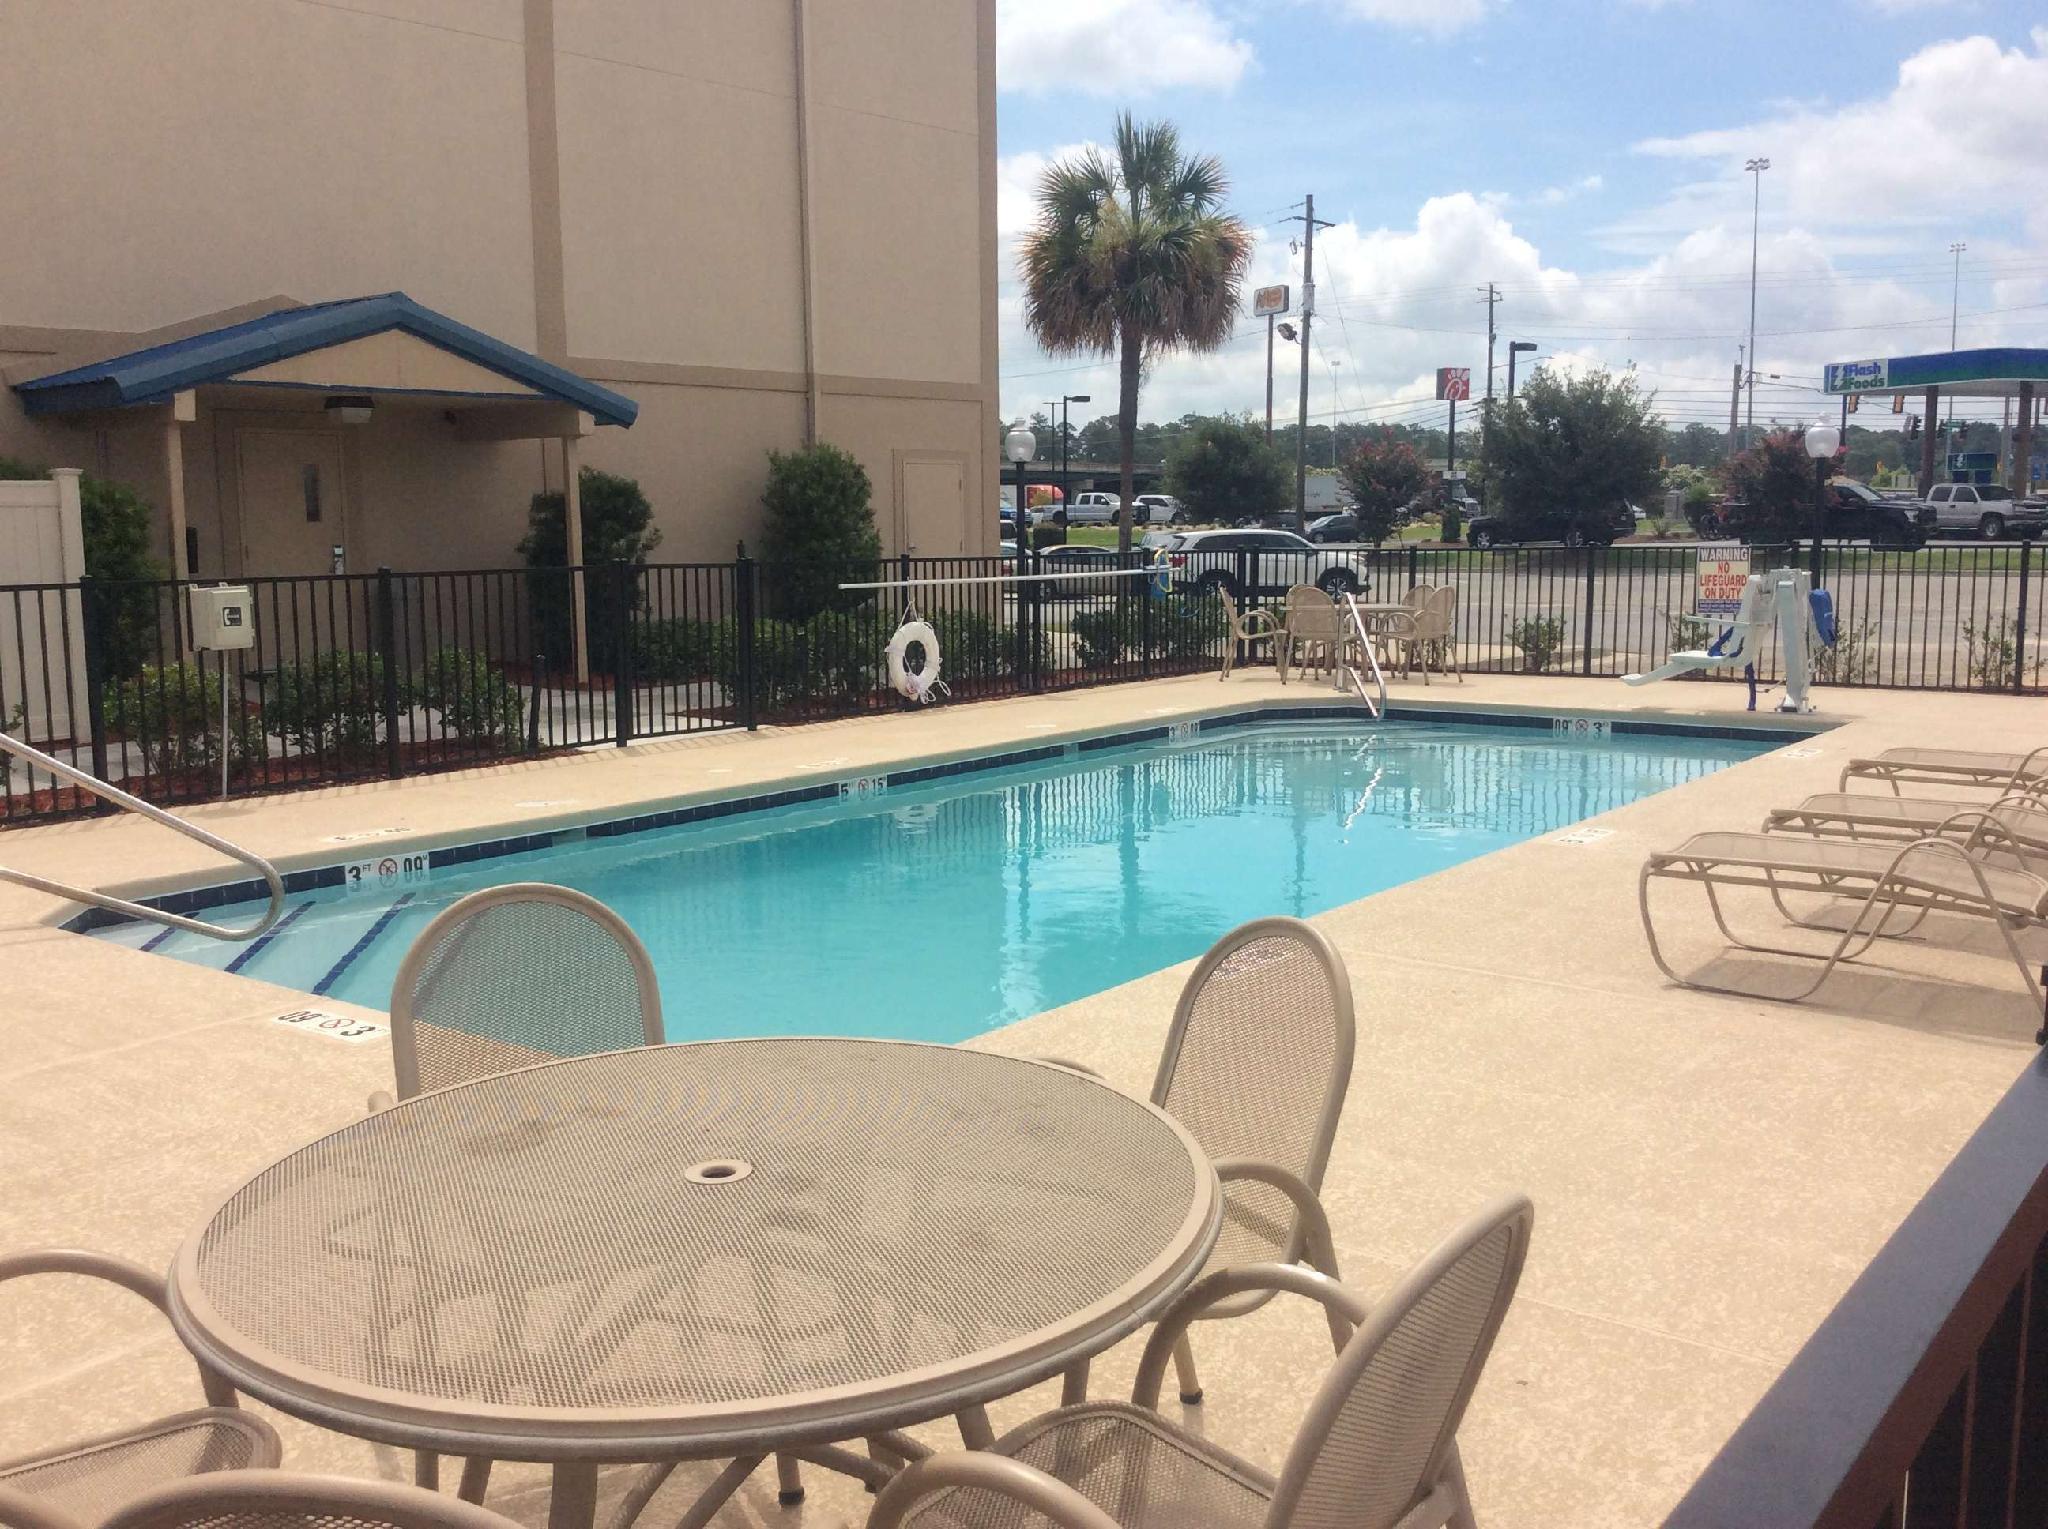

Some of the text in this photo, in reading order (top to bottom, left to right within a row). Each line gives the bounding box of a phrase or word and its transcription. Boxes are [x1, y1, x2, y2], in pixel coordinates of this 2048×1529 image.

[1848, 374, 1885, 389] Foods
[1700, 547, 1748, 561] WARNING
[1717, 561, 1730, 573] NO
[1700, 574, 1748, 587] LIFEGUARD
[1704, 587, 1742, 599] ON DUTY
